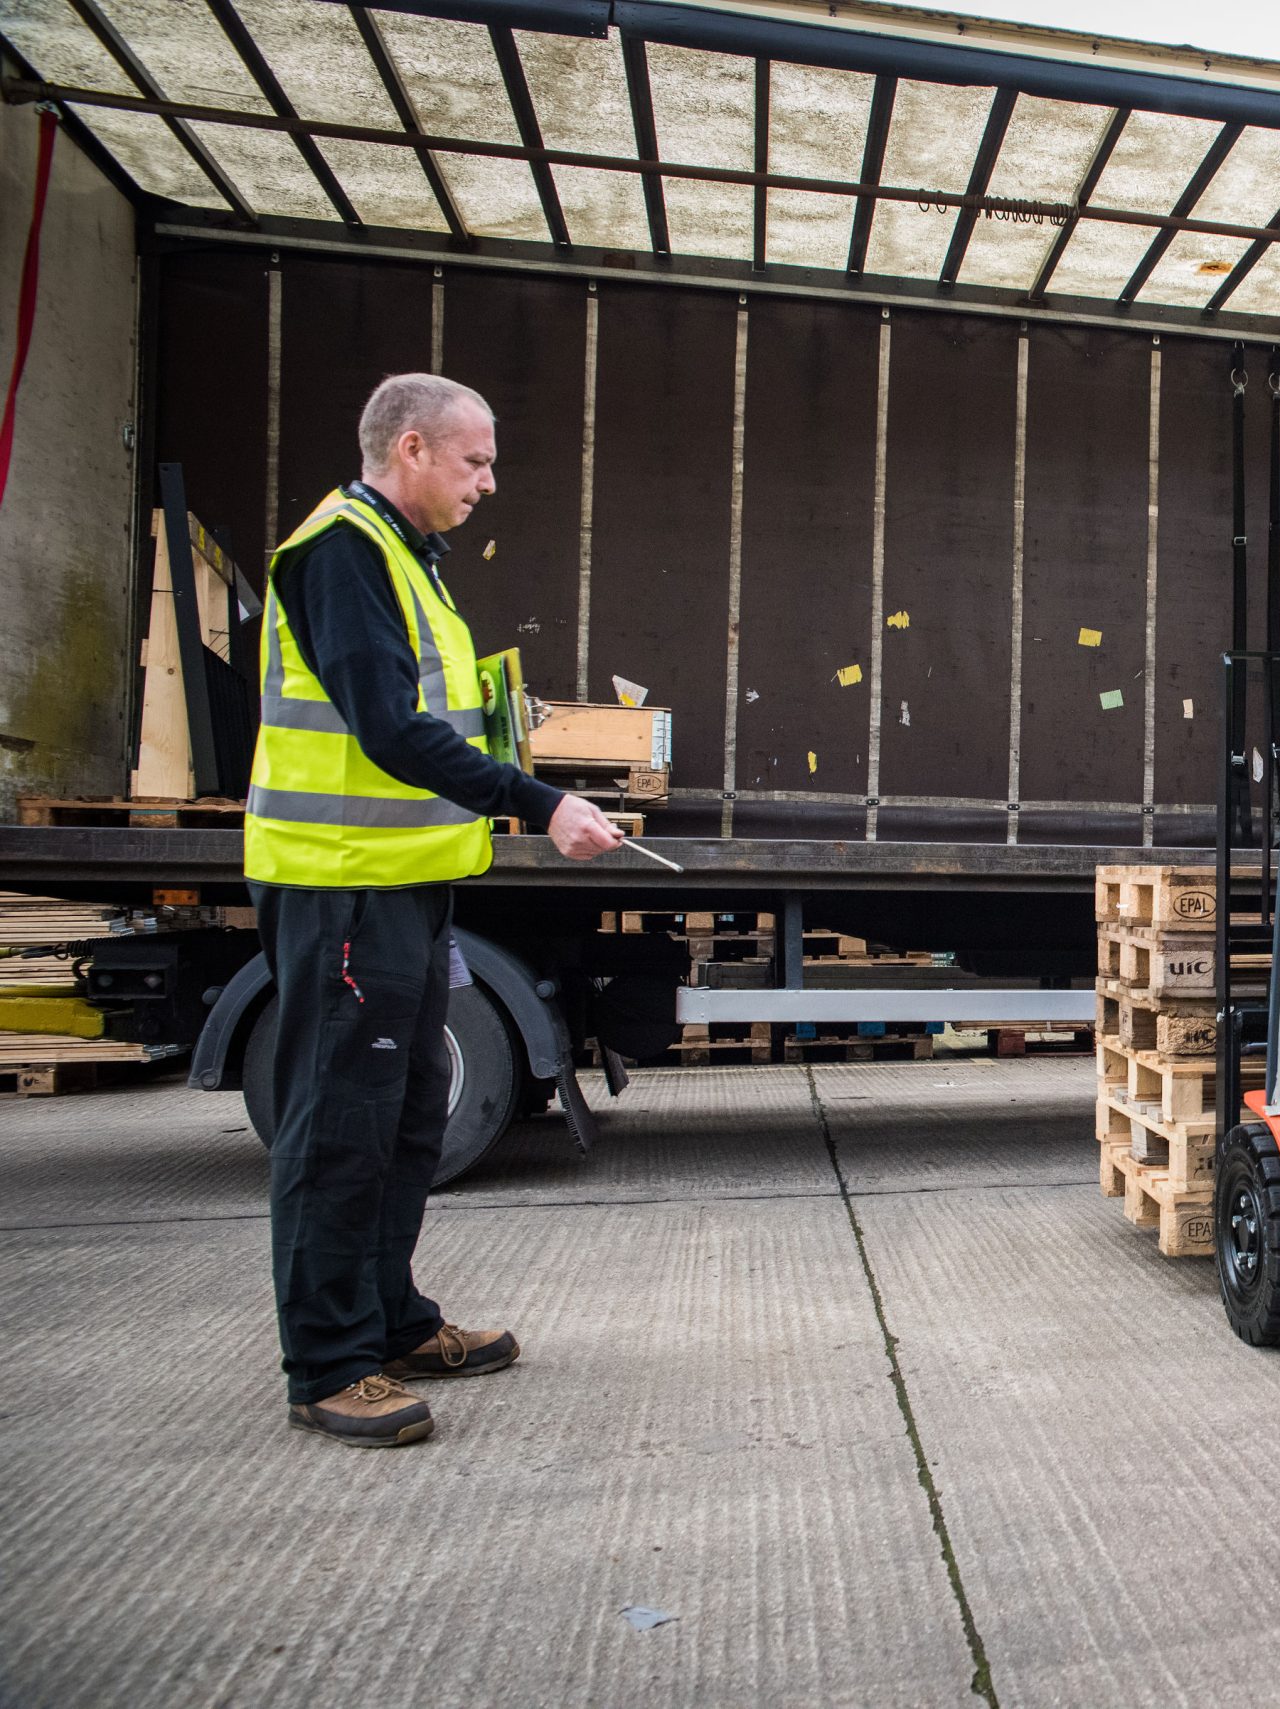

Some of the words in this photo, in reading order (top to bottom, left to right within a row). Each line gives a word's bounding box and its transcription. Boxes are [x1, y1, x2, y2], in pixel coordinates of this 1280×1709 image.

[636, 778, 657, 789] EPAL
[1180, 897, 1210, 913] EPAL
[1188, 1222, 1212, 1237] EPA
